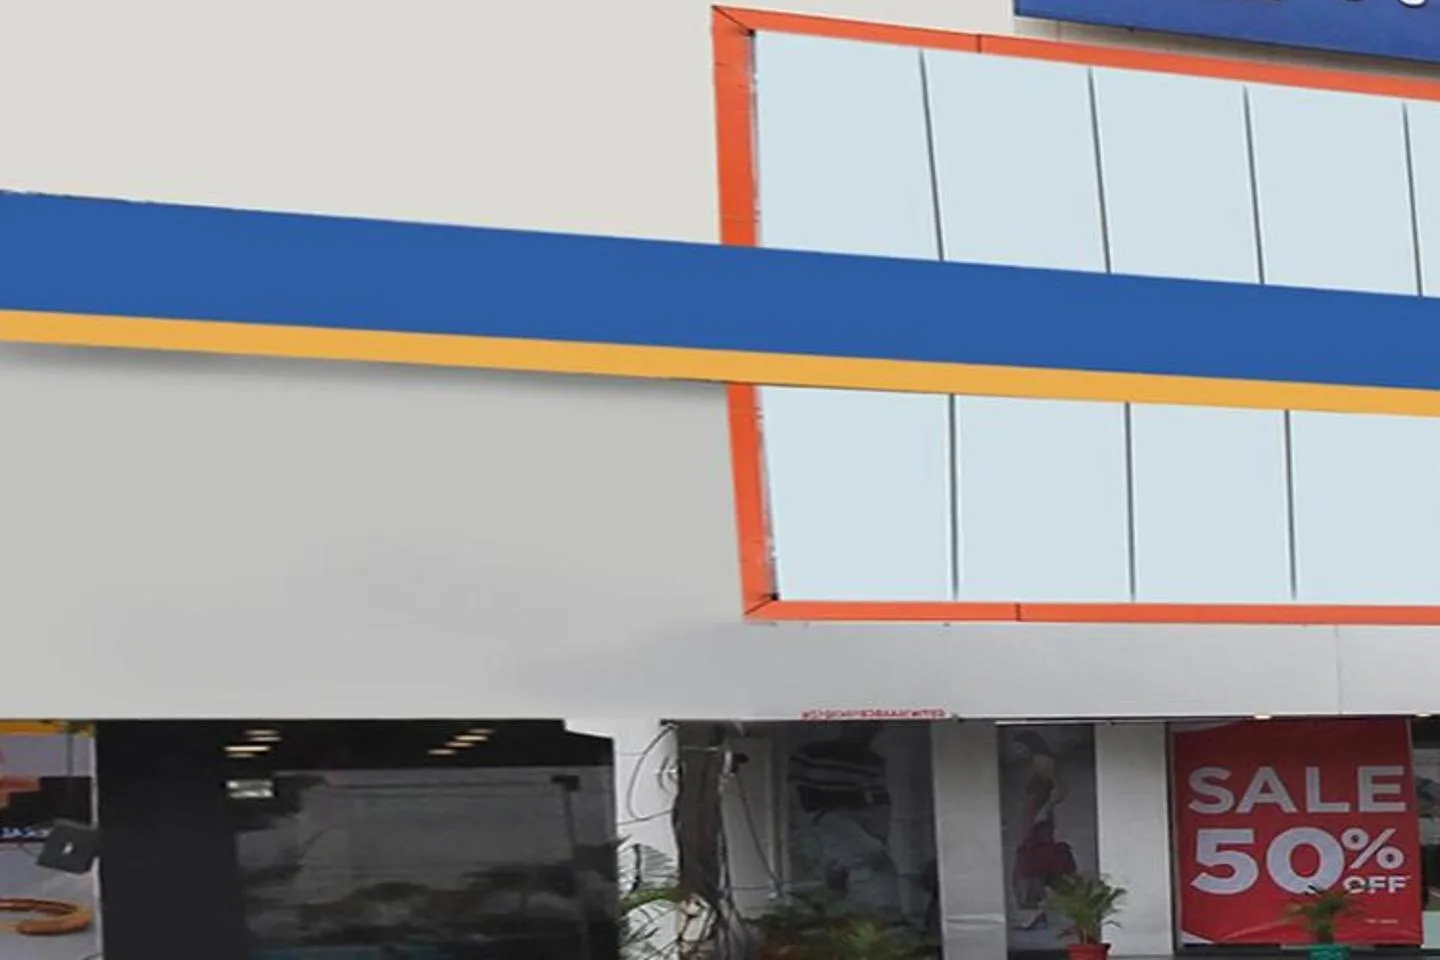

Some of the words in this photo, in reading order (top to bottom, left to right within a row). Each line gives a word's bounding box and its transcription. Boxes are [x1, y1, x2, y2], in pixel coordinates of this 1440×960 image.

[1187, 765, 1408, 815] SALE
[1189, 826, 1405, 896] 50%
[1342, 874, 1411, 894] OFF
